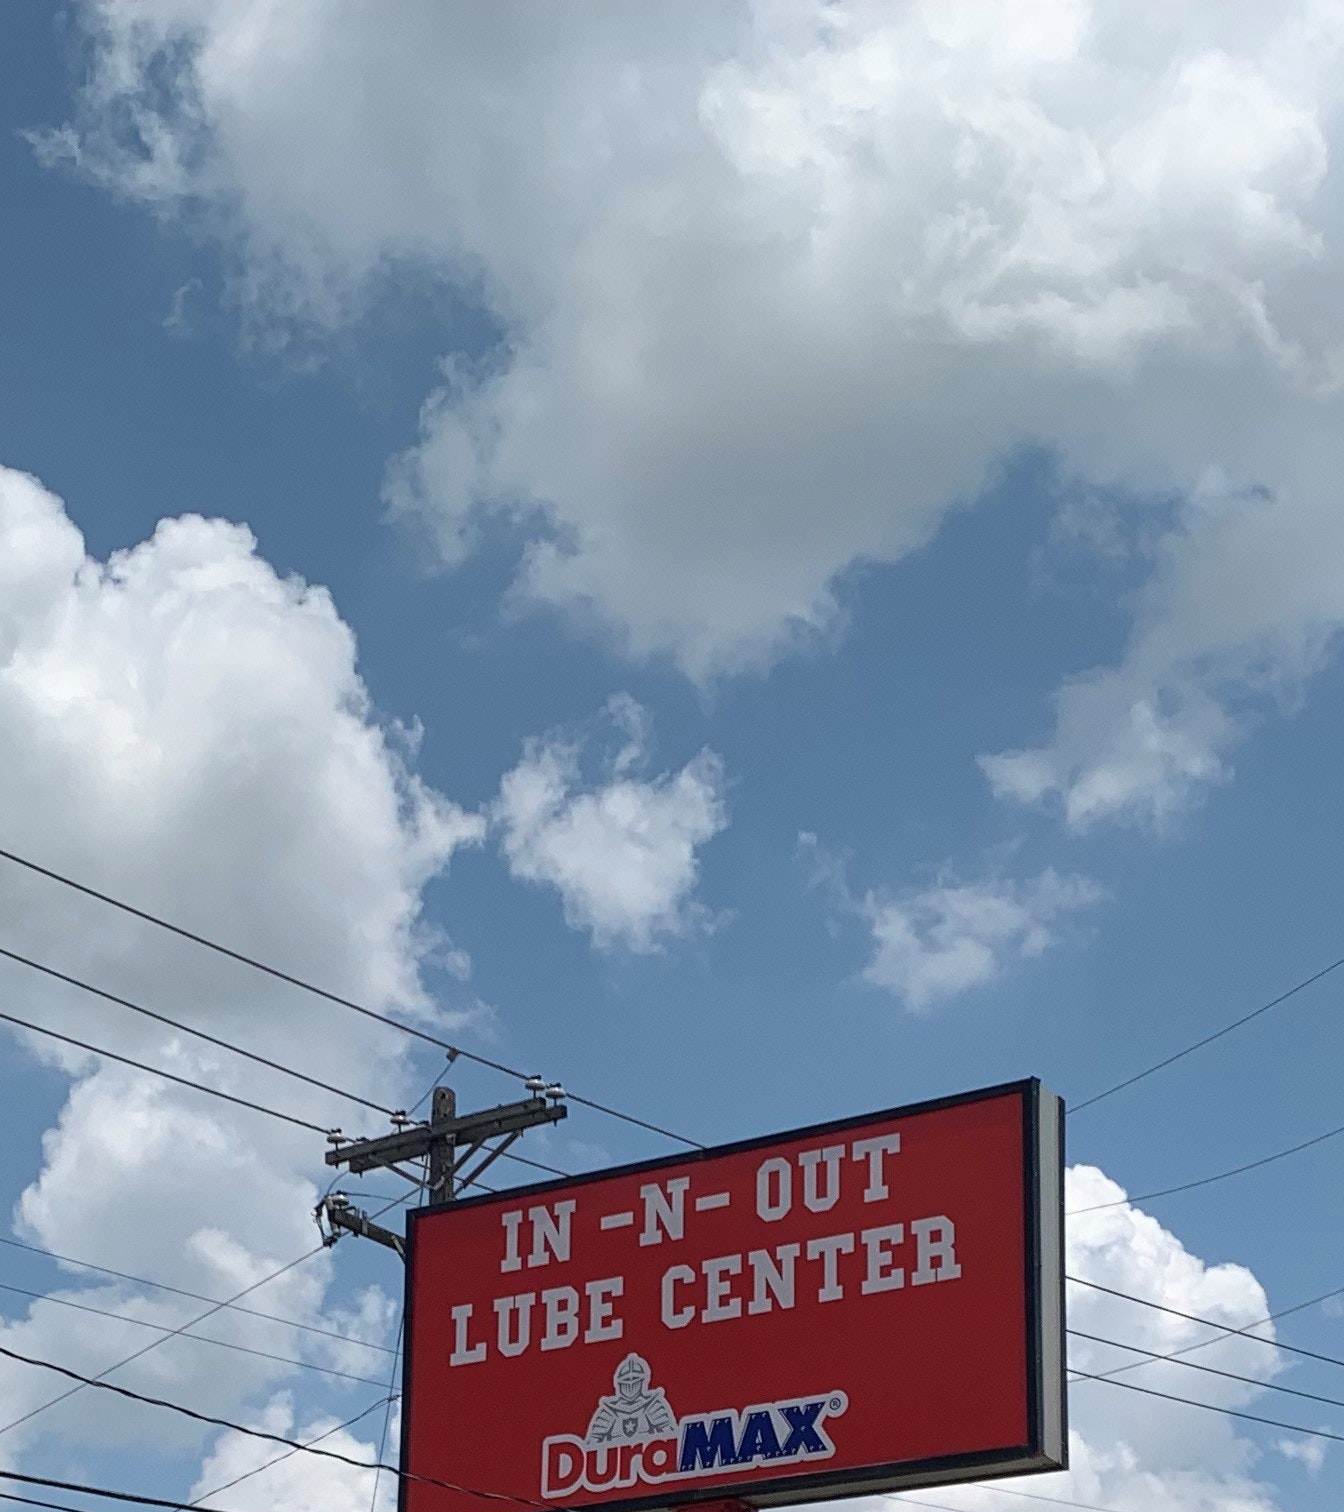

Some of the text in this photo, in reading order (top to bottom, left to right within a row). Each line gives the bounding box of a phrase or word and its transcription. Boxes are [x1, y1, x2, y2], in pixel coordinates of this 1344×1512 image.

[500, 1199, 577, 1274] IN
[756, 1132, 902, 1223] OUT
[449, 1214, 962, 1367] LUBE CENTER
